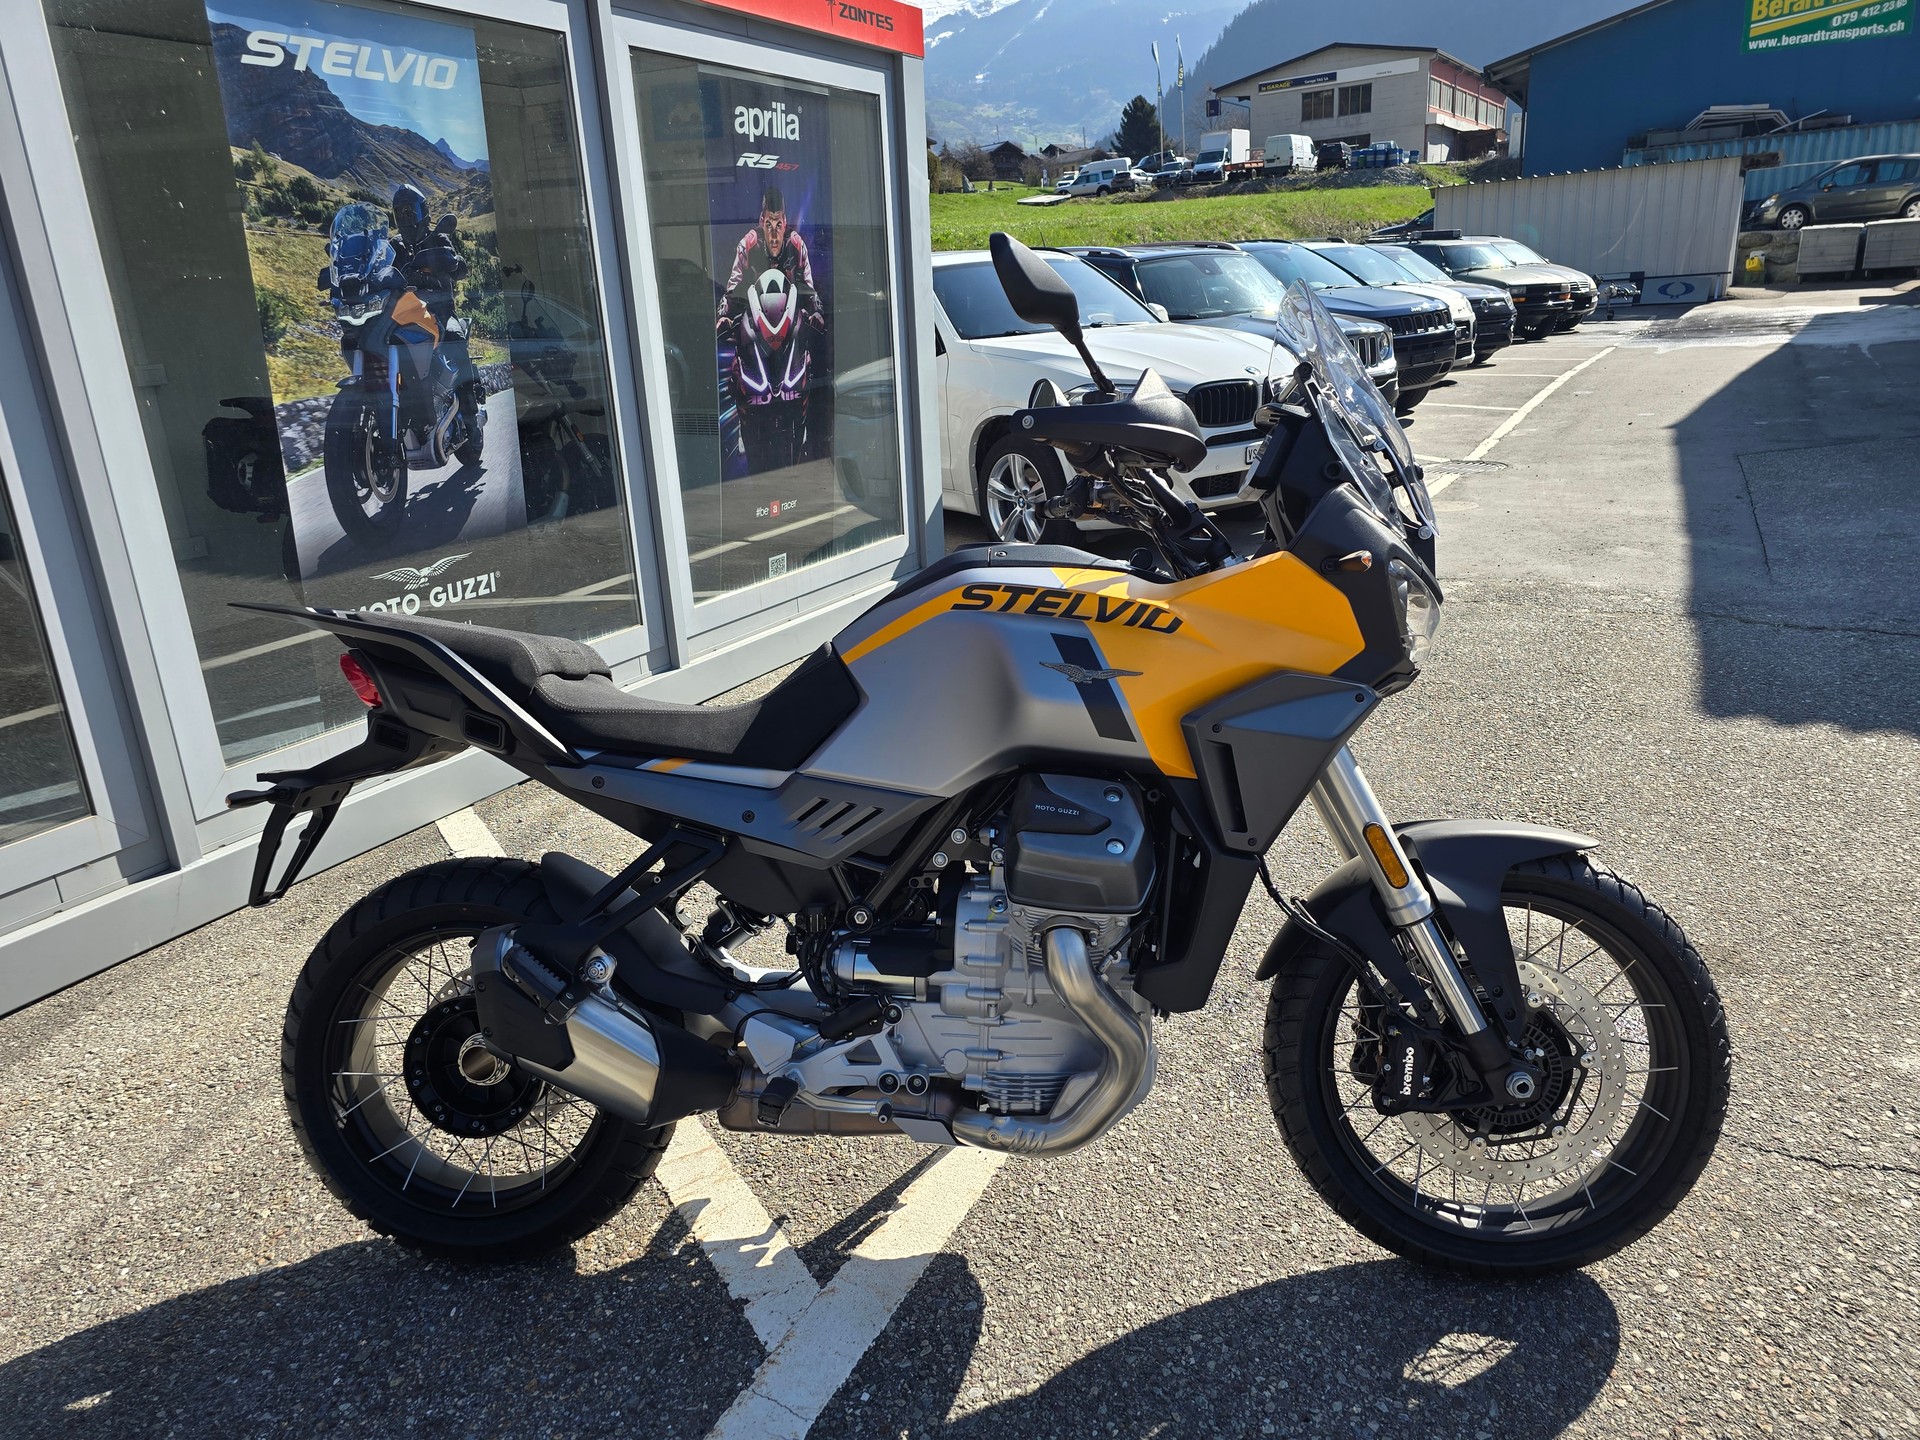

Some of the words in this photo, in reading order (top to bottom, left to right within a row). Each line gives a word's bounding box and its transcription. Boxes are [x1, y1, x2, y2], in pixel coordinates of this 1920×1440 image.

[839, 3, 894, 31] ZONTES
[1832, 11, 1858, 27] 079
[1861, 5, 1880, 18] 412
[1882, 2, 1895, 13] 23
[1749, 20, 1905, 50] www.berardtransports.ch
[240, 30, 458, 90] STELVIO
[1267, 82, 1291, 91] GARAGE
[734, 101, 800, 142] aprilia
[1248, 448, 1258, 460] VS
[756, 506, 770, 517] #be
[781, 499, 798, 511] racer
[350, 593, 421, 616] OTO
[429, 572, 496, 608] GUZZI
[950, 584, 1184, 635] STELVIO
[1035, 804, 1055, 812] MOTO
[1058, 807, 1079, 816] GUZZI
[1400, 1046, 1415, 1096] brembo
